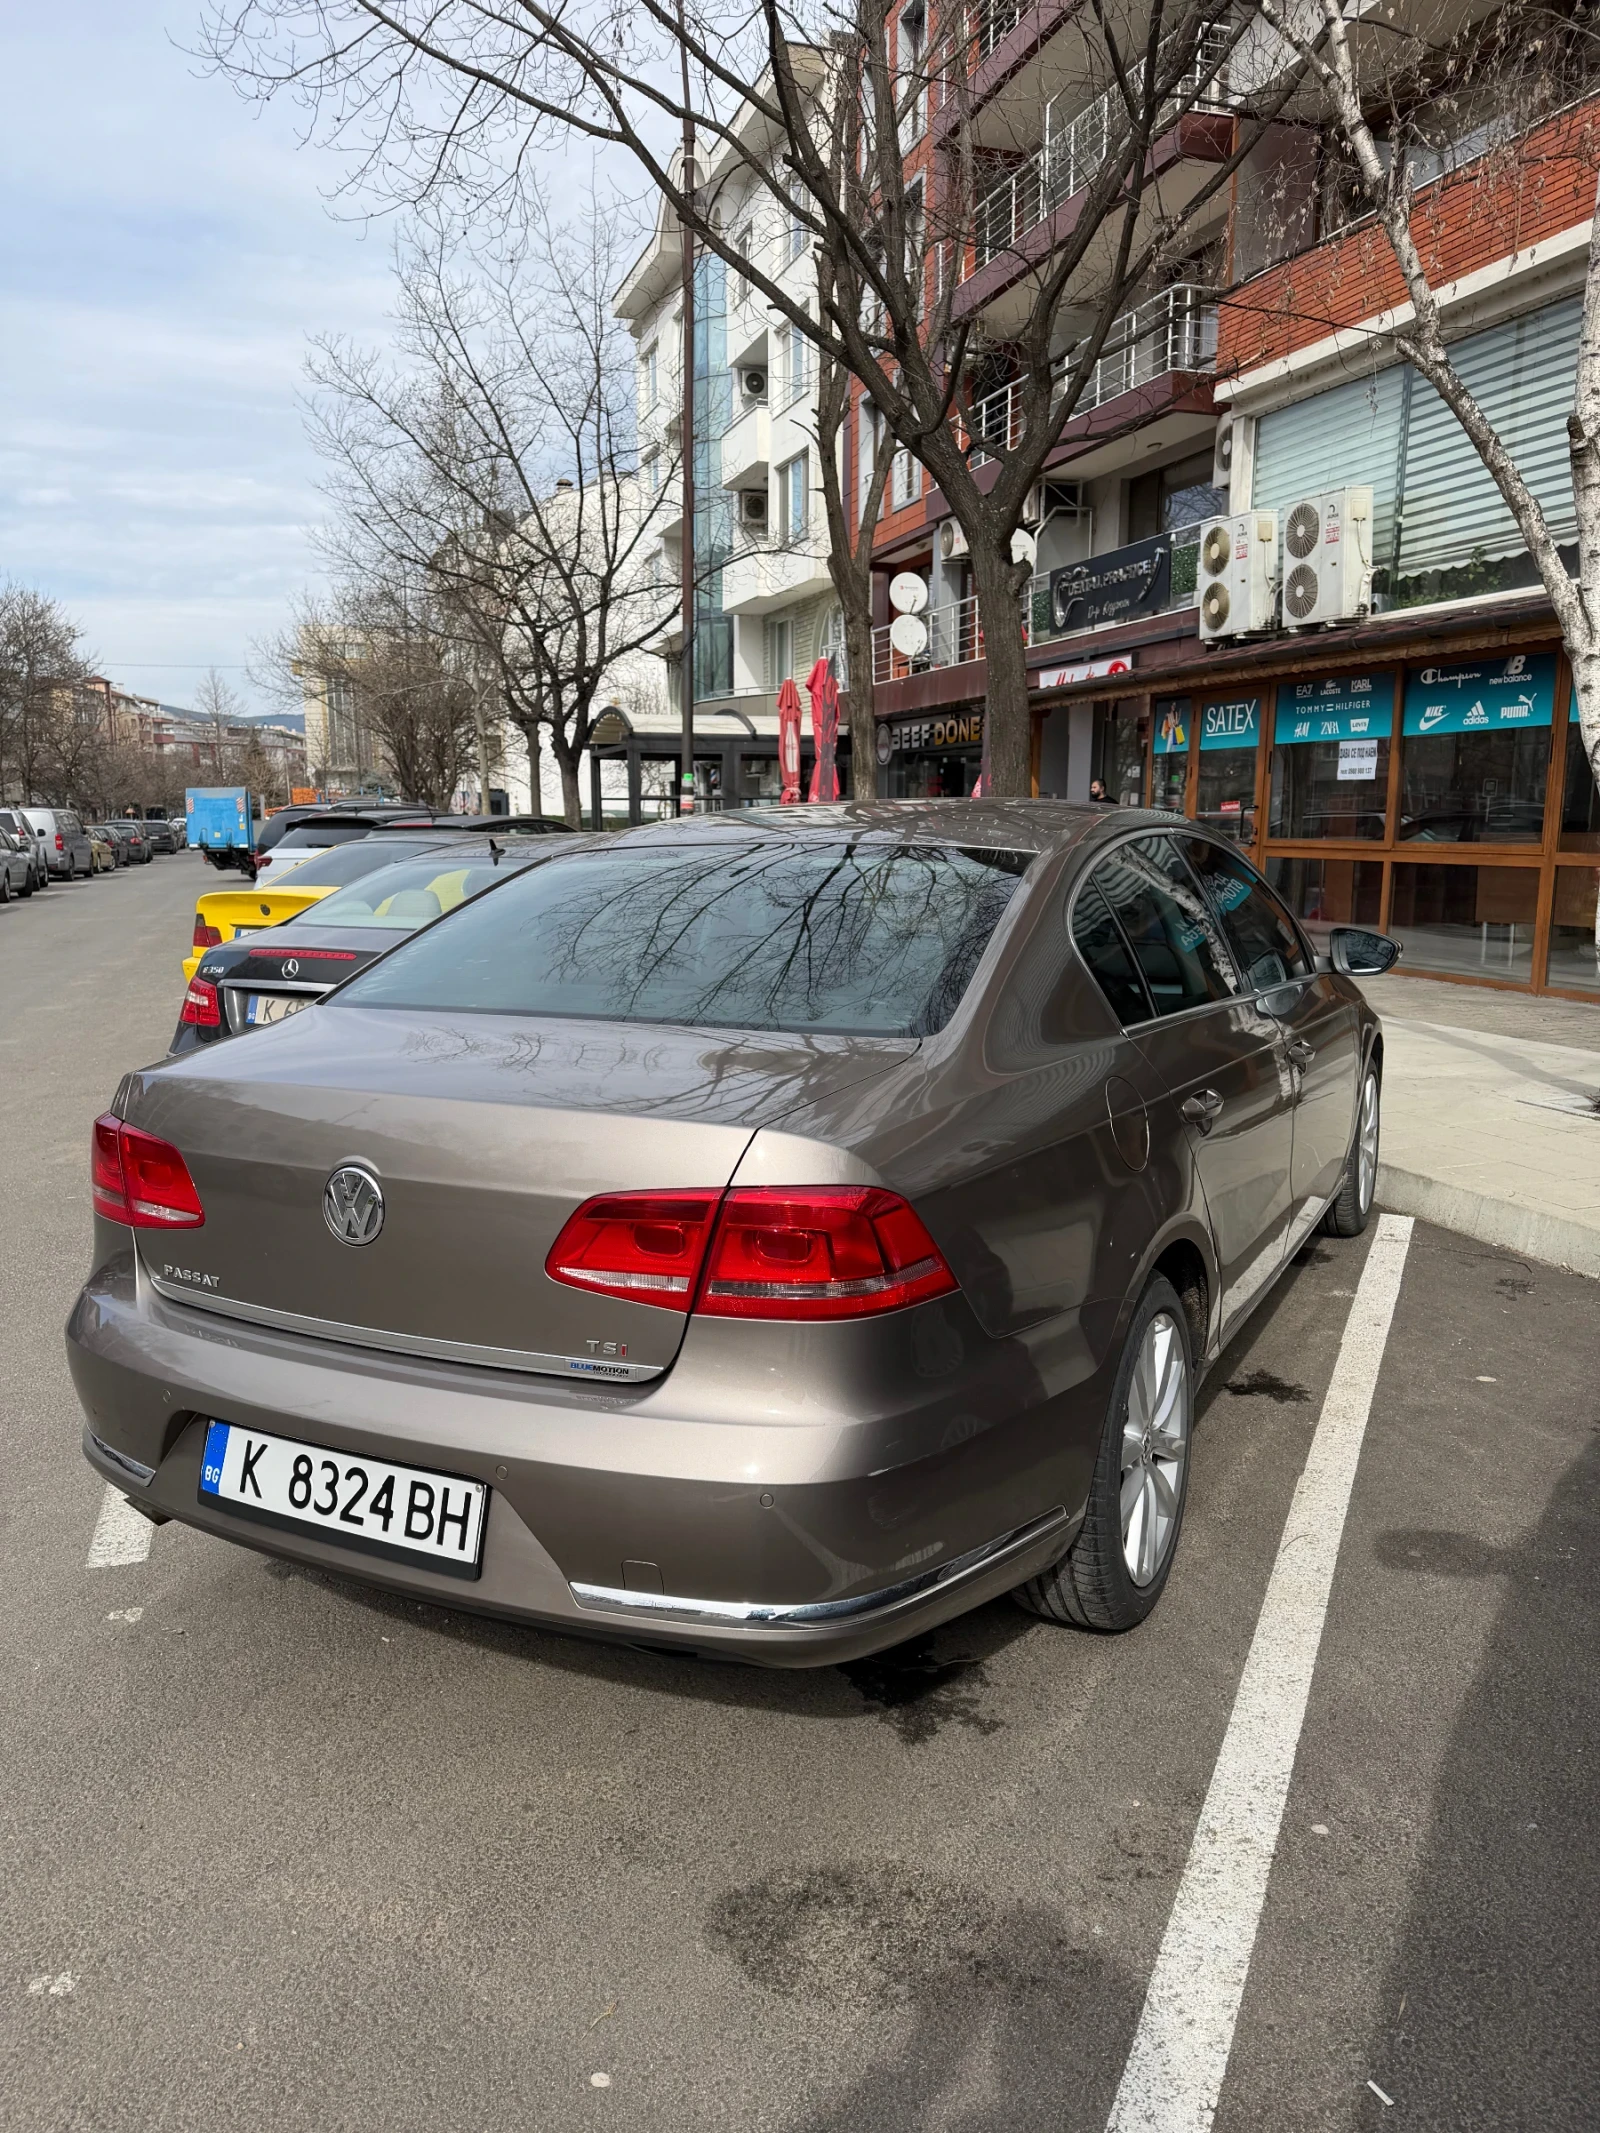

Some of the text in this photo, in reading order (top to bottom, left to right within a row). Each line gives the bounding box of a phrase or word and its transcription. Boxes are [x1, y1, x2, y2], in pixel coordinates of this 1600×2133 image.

[1503, 655, 1526, 675] NB
[1351, 679, 1372, 690] KARL
[1420, 668, 1482, 689] Champion
[1296, 684, 1313, 696] EA7
[1320, 688, 1341, 696] LACOSTE
[1296, 699, 1371, 715] TOMMY HILFIGER
[1425, 705, 1444, 717] NIKE
[1500, 705, 1528, 719] PUMA
[1206, 699, 1256, 734] SATEX
[1463, 714, 1489, 725] adidas
[1321, 721, 1340, 735] ZARA
[891, 723, 930, 751] BEEF
[263, 999, 276, 1022] K
[326, 1169, 381, 1242] VW
[163, 1264, 220, 1288] PASSAT
[586, 1340, 628, 1357] TSI
[569, 1361, 629, 1375] BLUEMOTION
[204, 1439, 473, 1552] BG K 8324 BH
